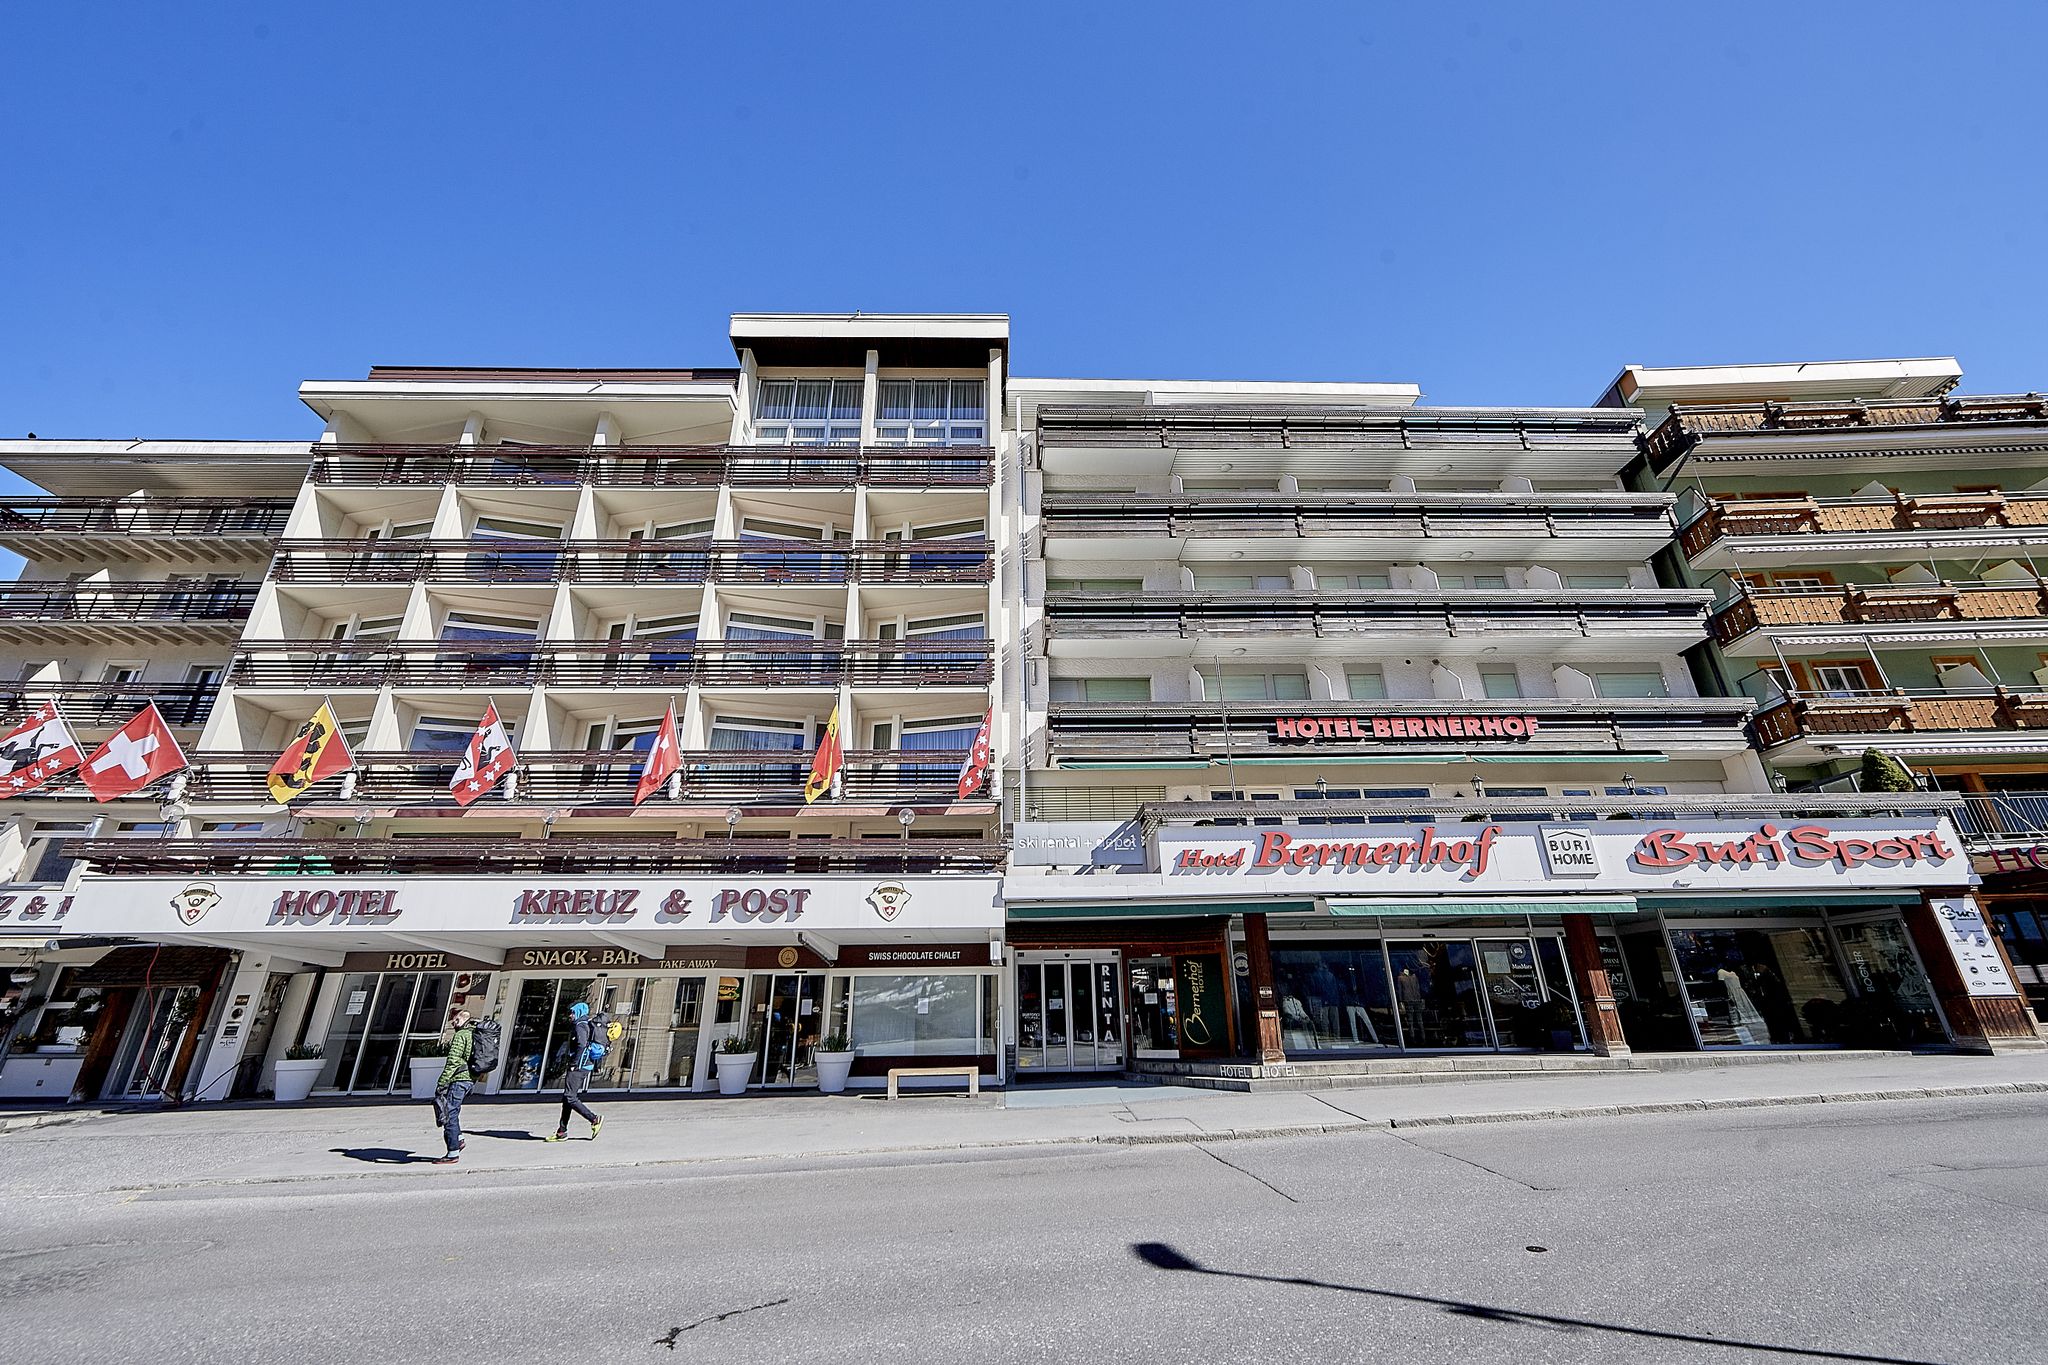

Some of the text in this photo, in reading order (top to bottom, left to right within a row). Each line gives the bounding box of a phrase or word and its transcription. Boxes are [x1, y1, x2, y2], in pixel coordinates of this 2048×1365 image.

[1276, 716, 1539, 738] HOTEL BERNERHOF
[1018, 835, 1137, 851] ski rental + depot
[1178, 825, 1503, 877] Hotel Bernerhof
[1549, 840, 1592, 852] BURI
[1634, 823, 1955, 867] Buri Sport
[1553, 853, 1595, 865] HOME
[24, 896, 49, 914] &
[275, 890, 403, 916] HOTEL
[518, 888, 811, 915] KREUZ & POST
[386, 953, 447, 969] HOTEL
[523, 949, 587, 966] SNACK
[601, 949, 640, 966] BAR
[659, 958, 718, 970] TAKE AWAY
[868, 951, 961, 961] SWISS CHOCOLATE CHALET
[1853, 951, 1875, 993] BOGNER
[1183, 959, 1212, 1045] Bernerhof
[1219, 1065, 1250, 1078] HOTEL
[1262, 1065, 1301, 1078] HOEL
